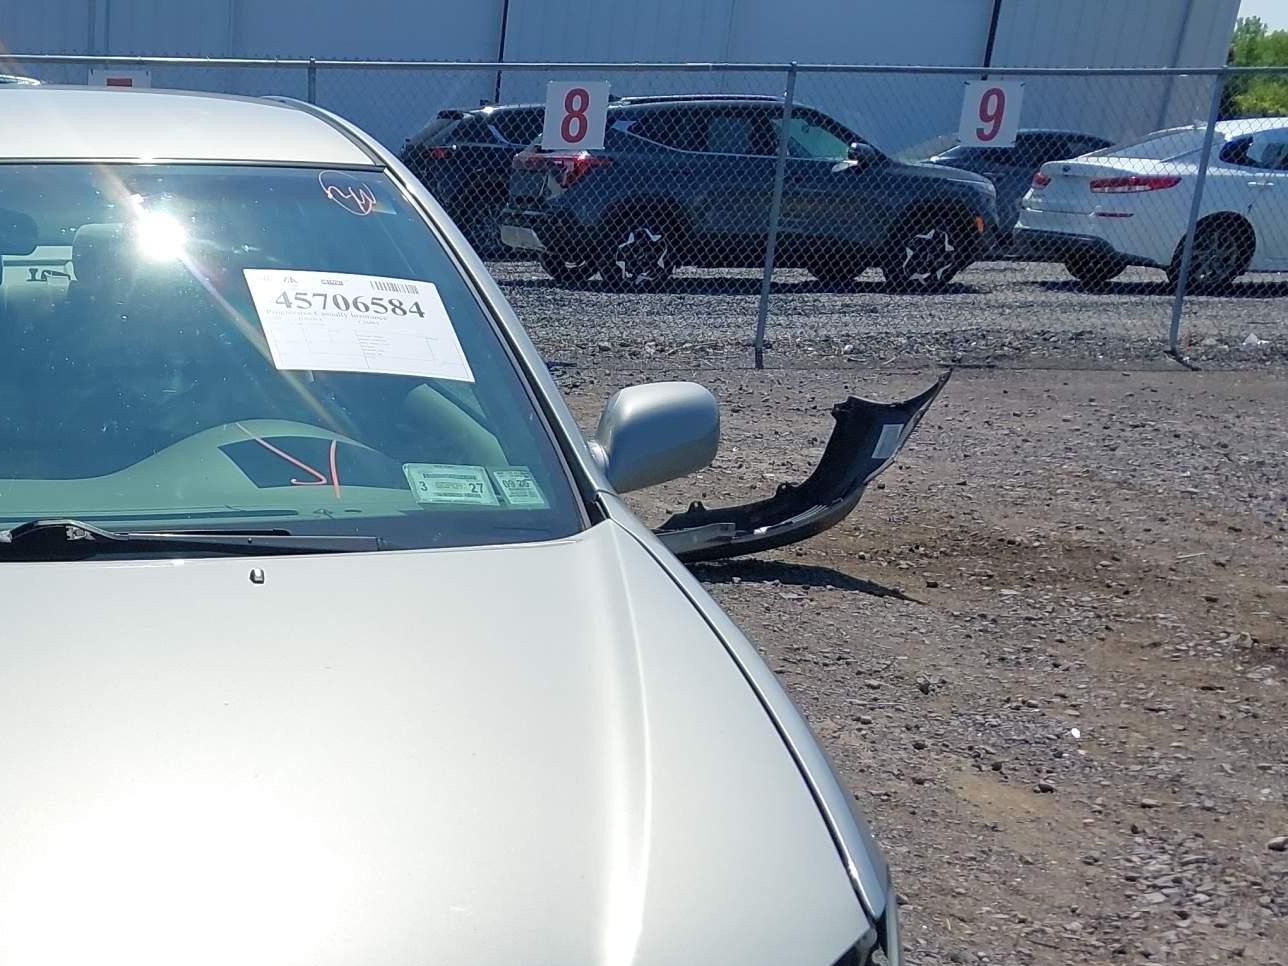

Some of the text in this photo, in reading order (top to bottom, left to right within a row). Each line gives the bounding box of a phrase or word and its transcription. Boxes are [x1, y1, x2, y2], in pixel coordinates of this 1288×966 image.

[561, 88, 590, 143] 8
[976, 87, 1005, 142] 9
[275, 290, 426, 319] 45706584
[418, 481, 428, 492] 3
[468, 482, 484, 494] 27
